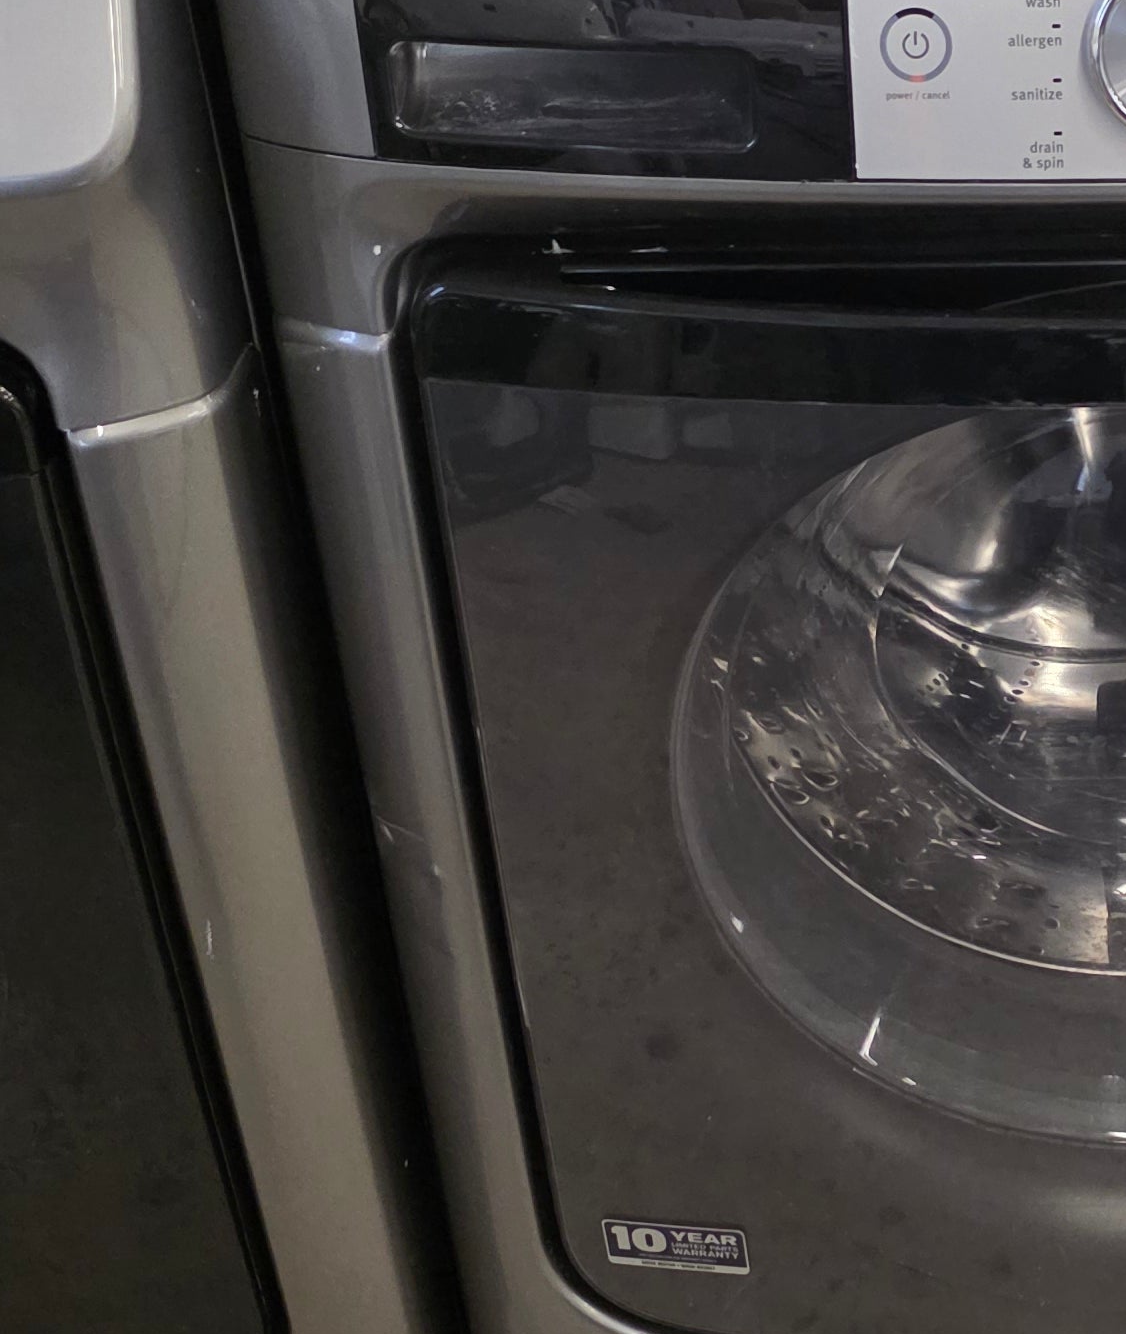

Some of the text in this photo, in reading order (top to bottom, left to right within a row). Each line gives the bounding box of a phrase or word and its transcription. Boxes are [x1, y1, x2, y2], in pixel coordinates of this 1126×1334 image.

[1008, 33, 1063, 49] allergen
[885, 92, 913, 101] power
[922, 91, 950, 100] cancel
[1011, 88, 1063, 101] sanitize
[1029, 141, 1064, 154] drain
[1022, 156, 1065, 171] & spin
[610, 1225, 738, 1253] 10 YEAR
[672, 1248, 740, 1260] WARRANTY
